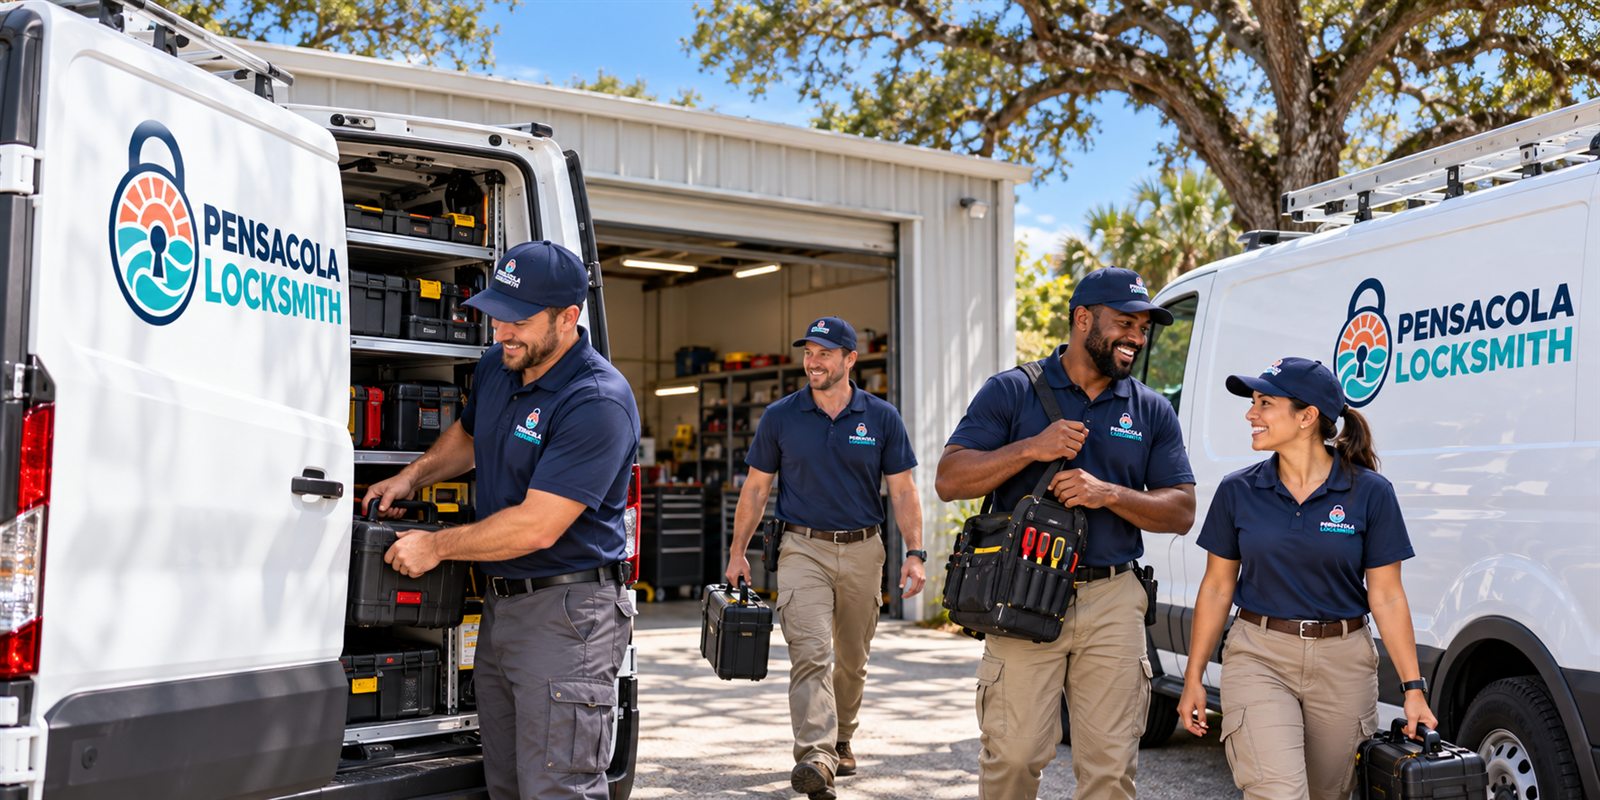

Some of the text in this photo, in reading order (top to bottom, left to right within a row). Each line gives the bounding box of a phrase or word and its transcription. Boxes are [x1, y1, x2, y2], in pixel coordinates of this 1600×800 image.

[203, 202, 341, 283] PENSACOLA
[204, 257, 342, 325] LOCKSMITH
[1397, 282, 1575, 344] PENSACOLA
[1395, 326, 1573, 384] LOCKSMITH
